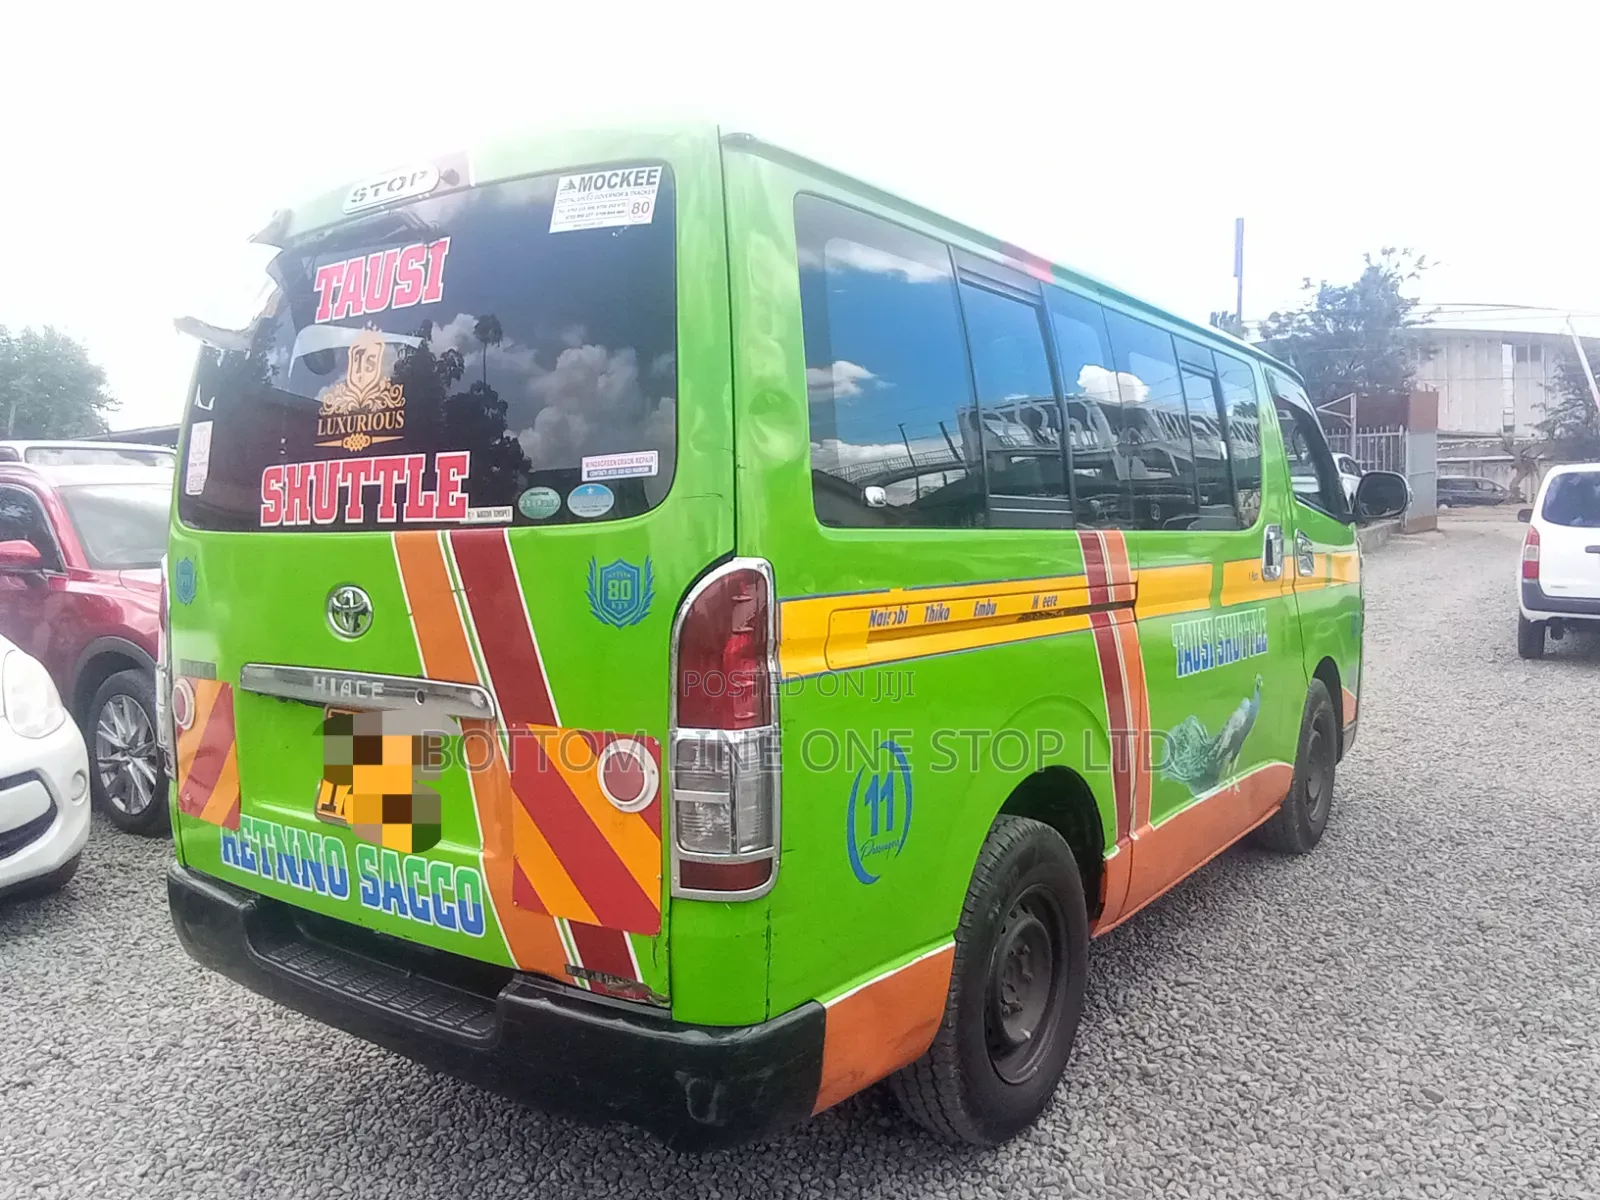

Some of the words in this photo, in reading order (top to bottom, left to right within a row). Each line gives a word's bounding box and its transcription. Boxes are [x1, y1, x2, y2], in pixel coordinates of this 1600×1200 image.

[350, 170, 428, 203] STOP
[578, 168, 660, 193] MOCKEE
[631, 201, 650, 215] 80
[313, 236, 452, 324] TAUSI
[317, 410, 405, 436] LUXURIOUS
[259, 451, 470, 526] SHUTTLE
[607, 579, 632, 601] 80
[924, 602, 950, 623] Thika
[973, 599, 998, 617] Embu
[1171, 617, 1215, 679] TAUSI
[1215, 607, 1269, 667] SHUTTLE
[313, 675, 385, 699] HIACE
[864, 770, 895, 837] 11
[355, 843, 486, 938] SACCO
